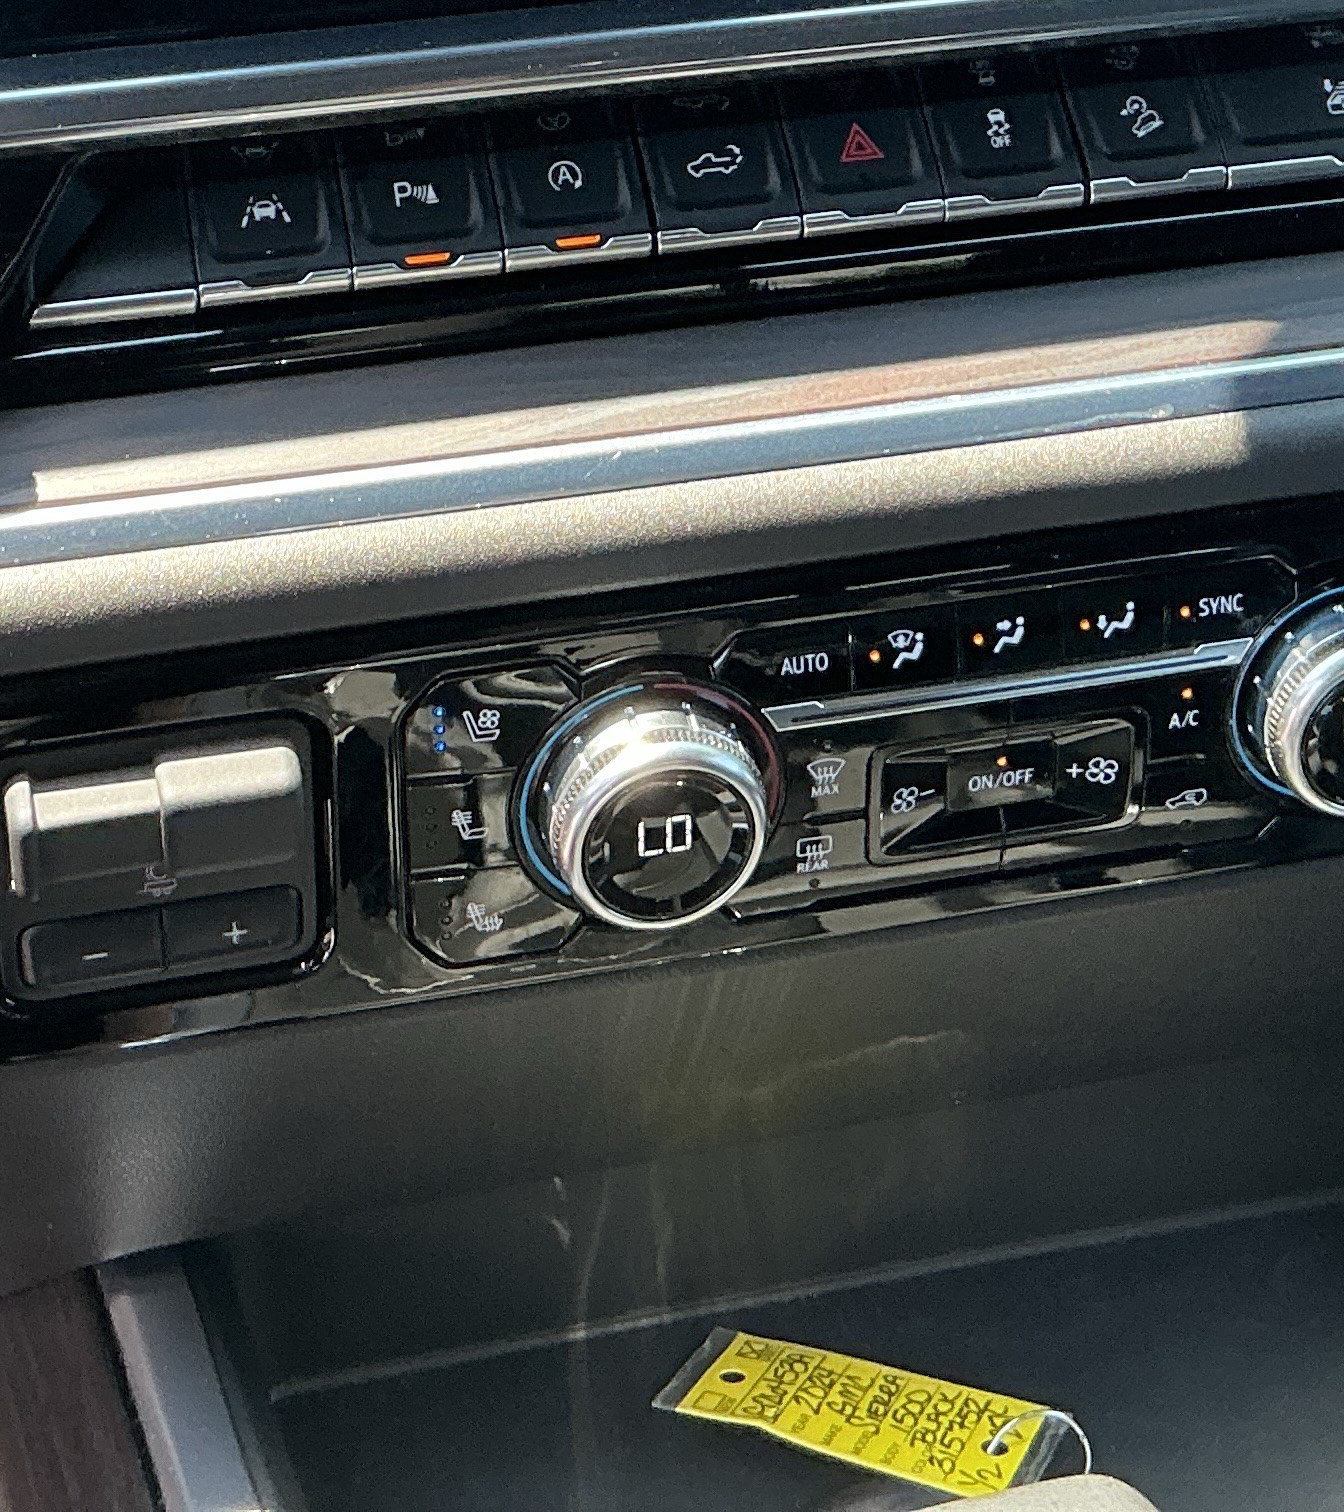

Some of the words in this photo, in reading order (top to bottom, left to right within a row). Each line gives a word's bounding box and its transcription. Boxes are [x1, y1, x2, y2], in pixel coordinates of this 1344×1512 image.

[394, 182, 412, 207] P
[1198, 593, 1245, 617] SYNC
[780, 652, 829, 676] AUTO
[1168, 708, 1200, 730] A/C
[811, 783, 839, 798] MAX
[968, 767, 1035, 792] ON/OFF
[797, 859, 829, 873] REAR
[794, 1367, 842, 1415] 2024
[890, 1389, 931, 1434] 1500
